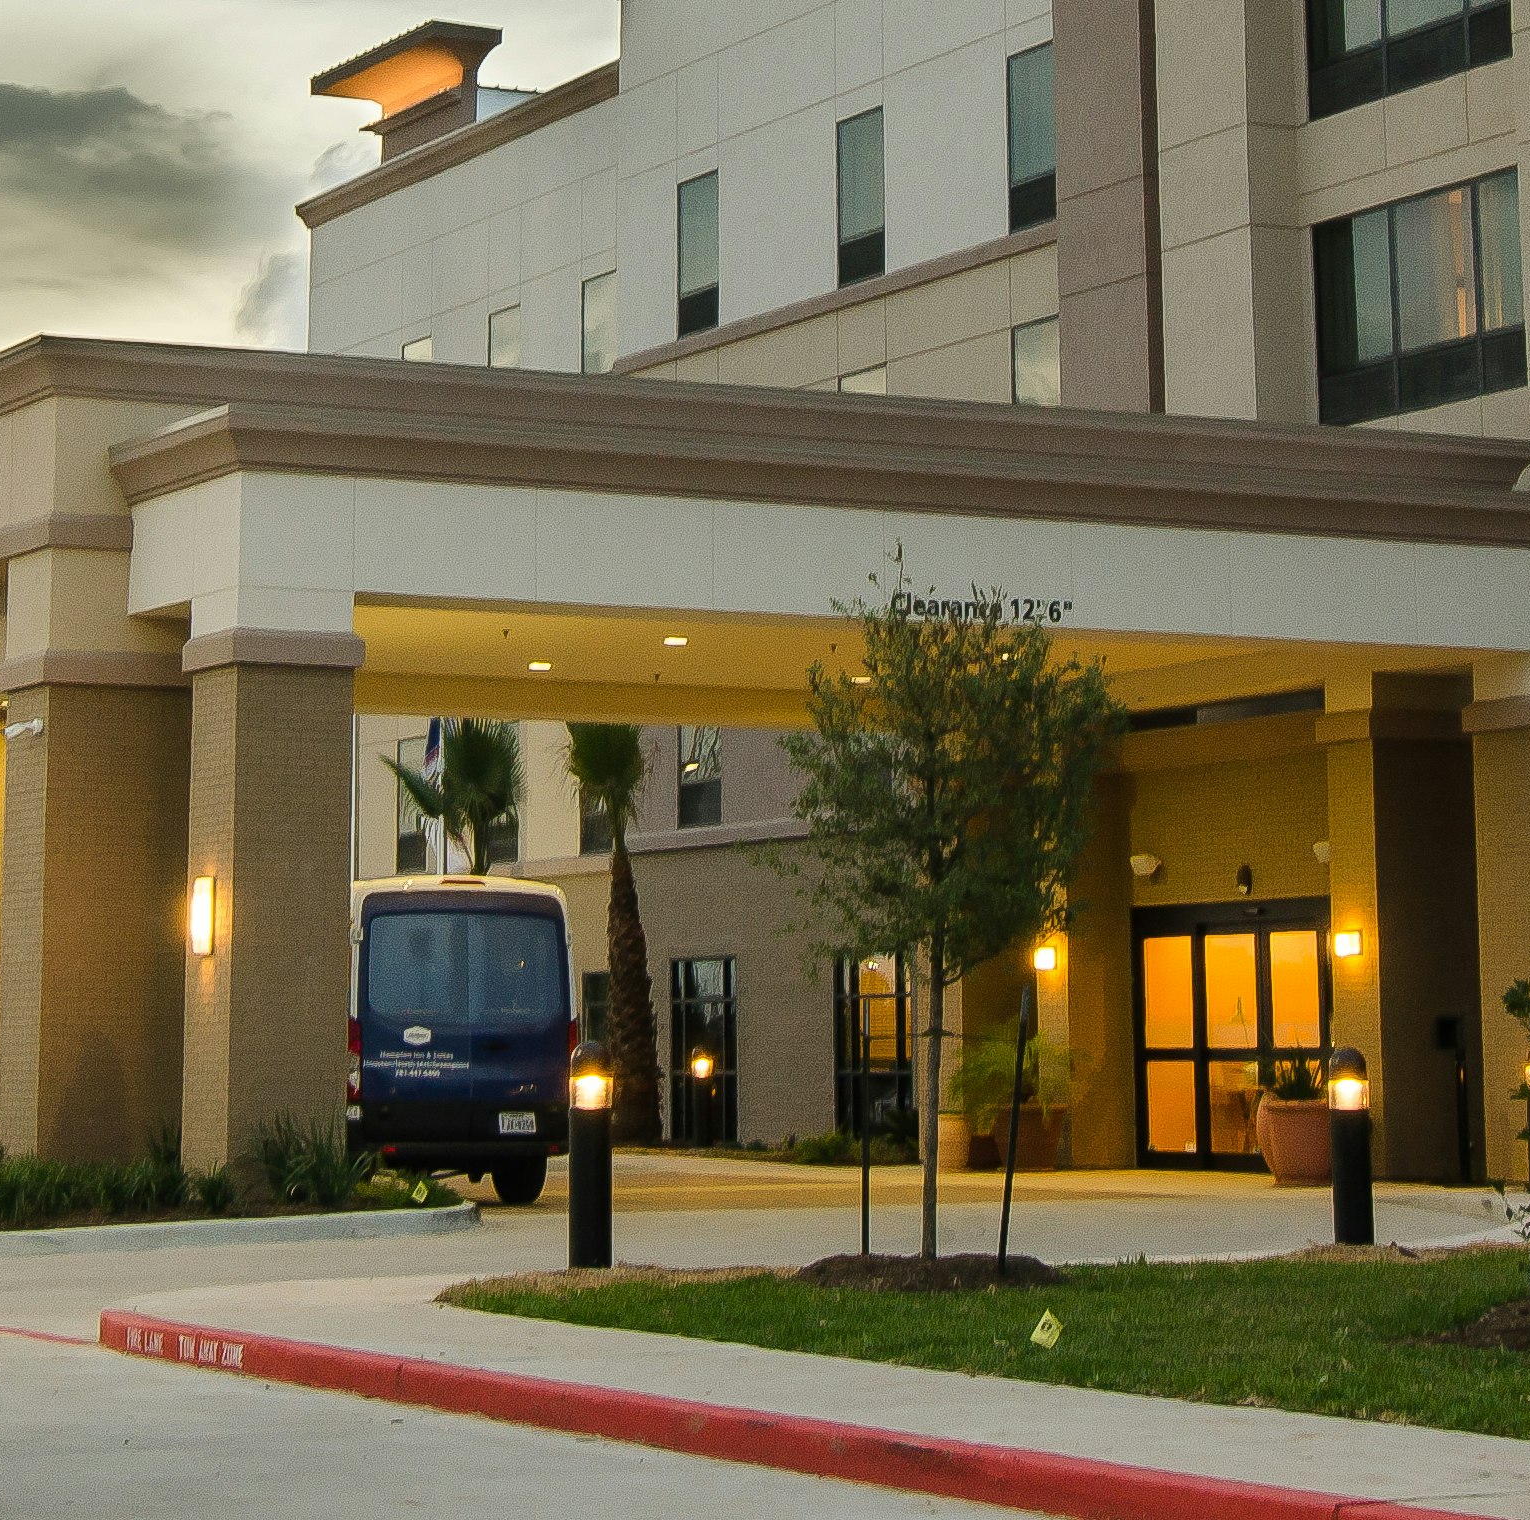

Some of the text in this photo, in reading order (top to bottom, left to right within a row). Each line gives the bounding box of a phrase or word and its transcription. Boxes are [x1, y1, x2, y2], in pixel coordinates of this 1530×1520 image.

[144, 1329, 164, 1356] LANE
[178, 1333, 196, 1361] TOW
[221, 1340, 245, 1369] ZONE
